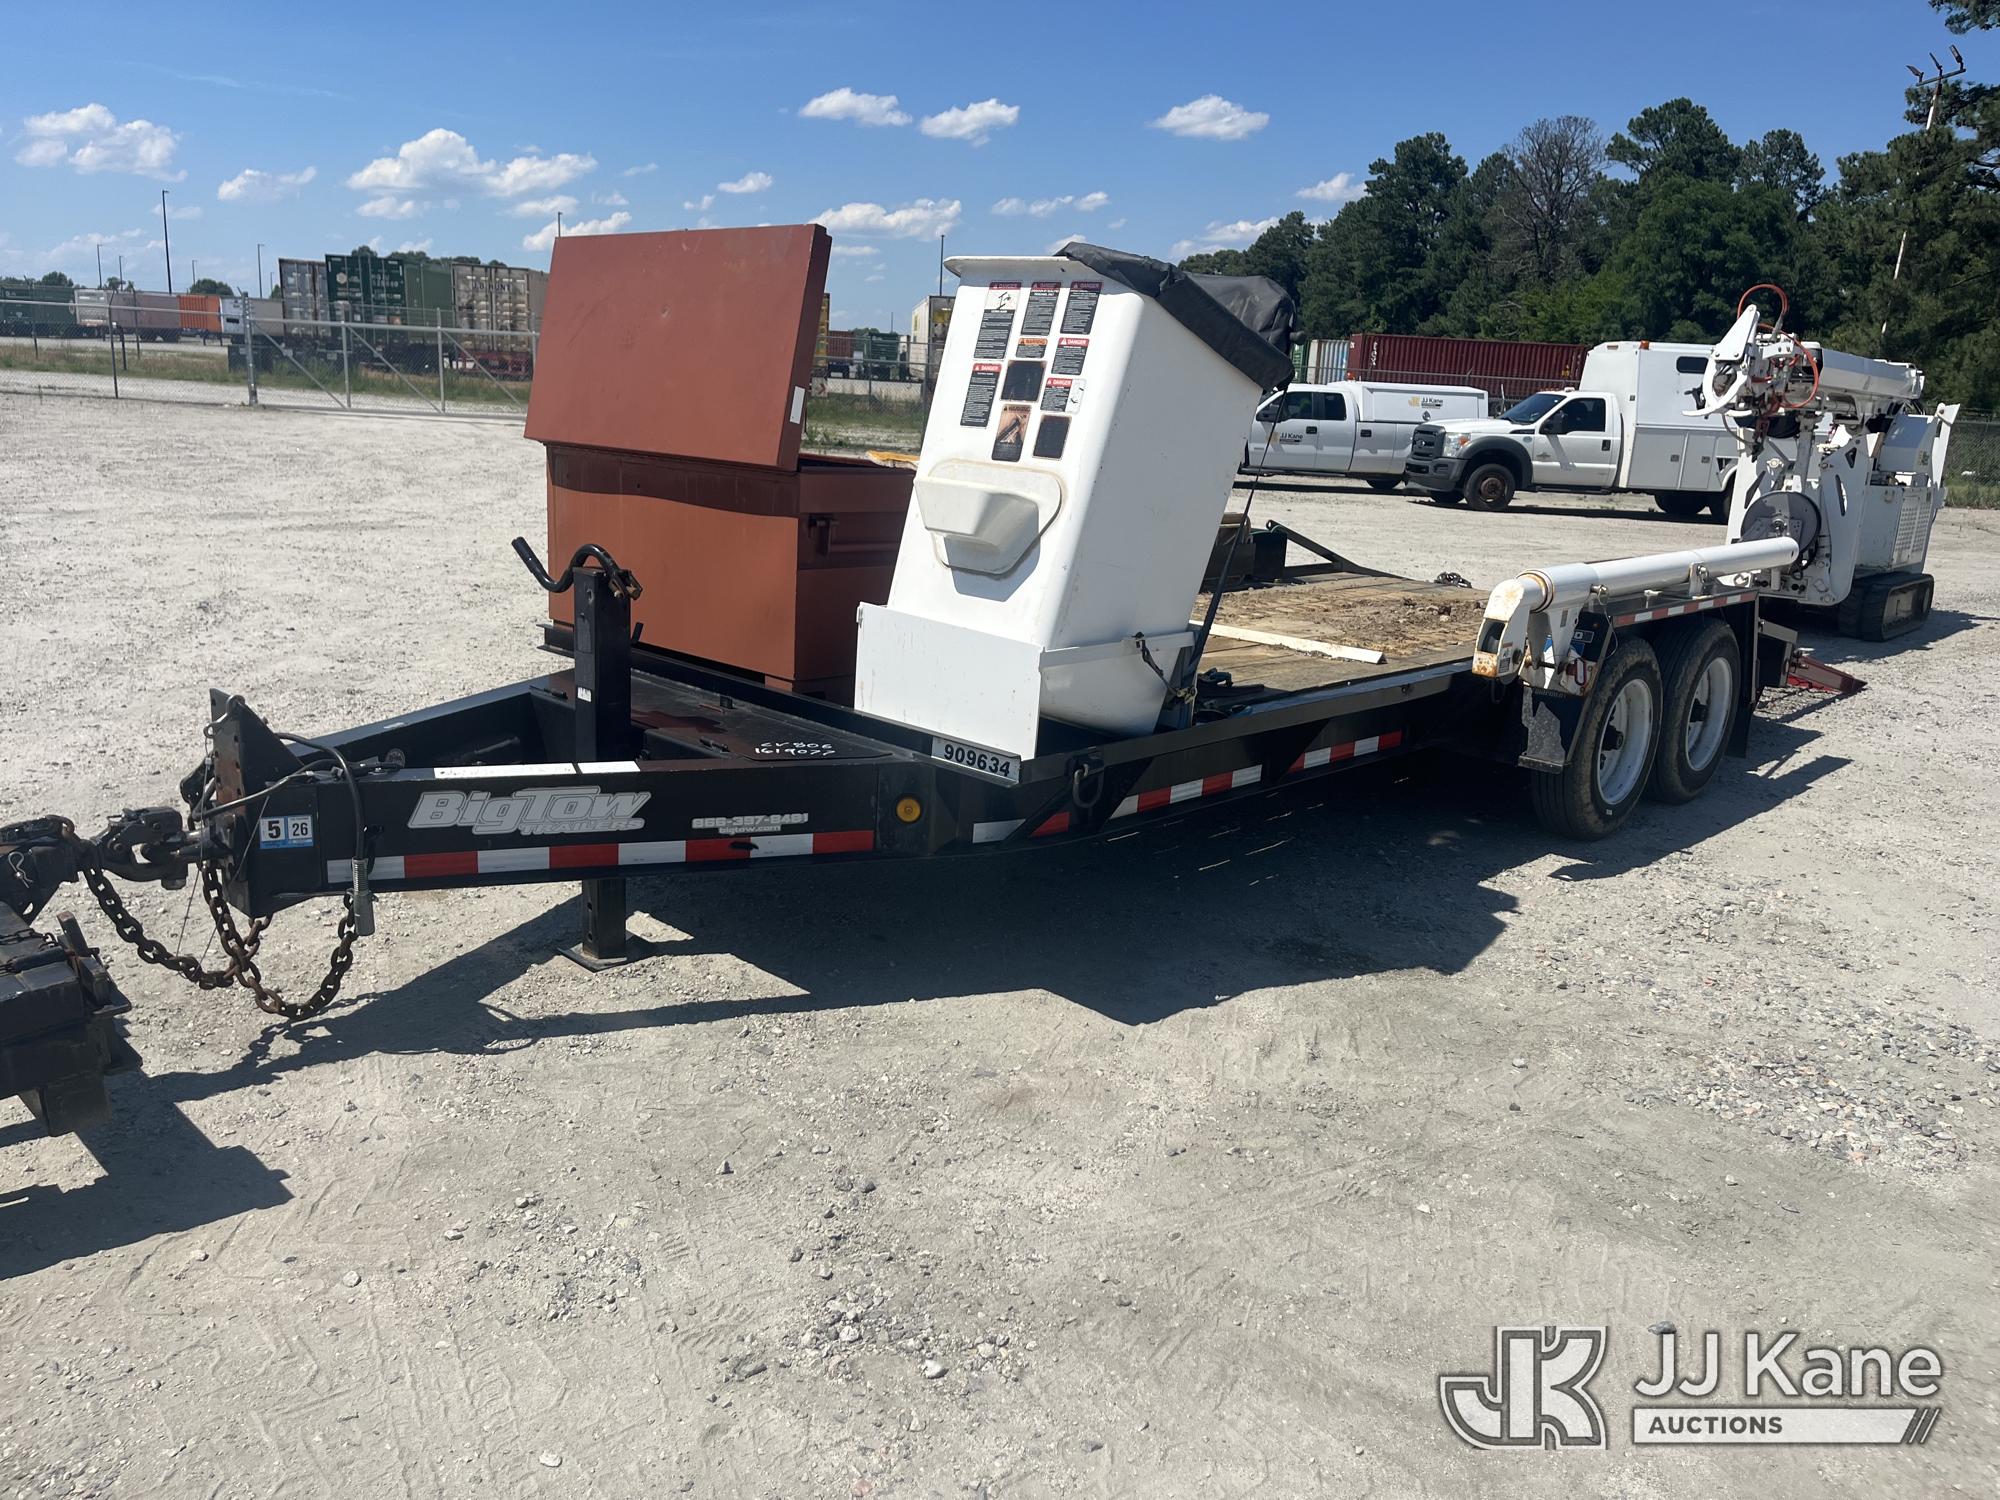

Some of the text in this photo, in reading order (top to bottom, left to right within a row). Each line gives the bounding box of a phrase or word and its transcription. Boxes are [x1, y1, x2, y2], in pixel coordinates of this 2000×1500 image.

[943, 743, 1010, 777] 909634
[268, 819, 308, 839] 5 26
[520, 818, 645, 835] TRAILERS
[719, 825, 781, 836] bigtow.com
